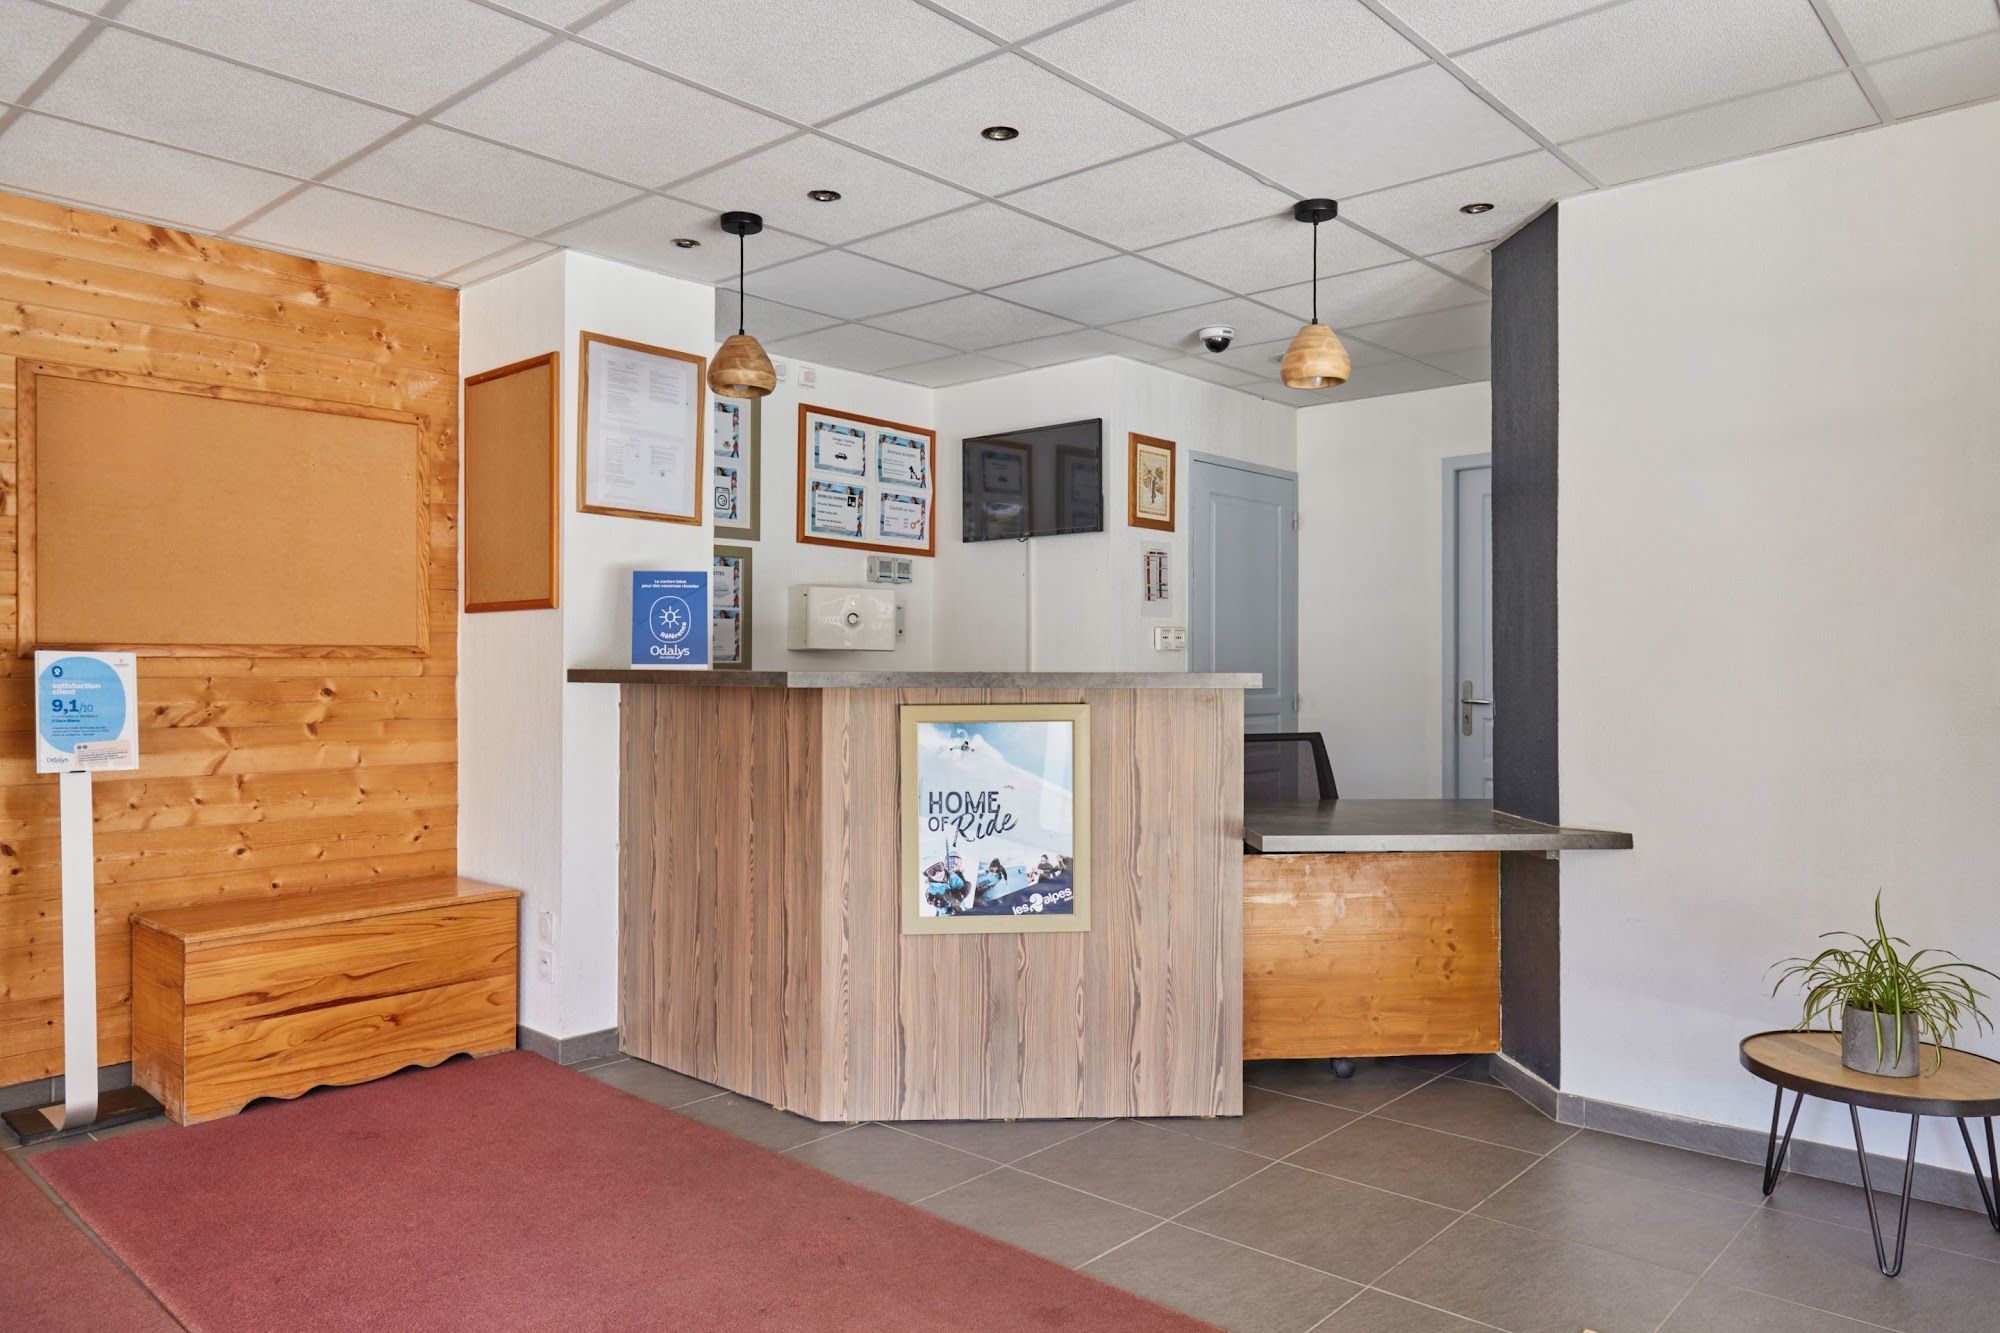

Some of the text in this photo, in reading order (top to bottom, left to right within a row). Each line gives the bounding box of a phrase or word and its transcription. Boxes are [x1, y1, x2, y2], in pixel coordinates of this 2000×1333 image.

[650, 644, 690, 659] Odalys
[929, 791, 1000, 814] HOME
[928, 804, 1020, 847] OF Ride
[1012, 904, 1029, 915] les
[1043, 888, 1072, 904] alpes
